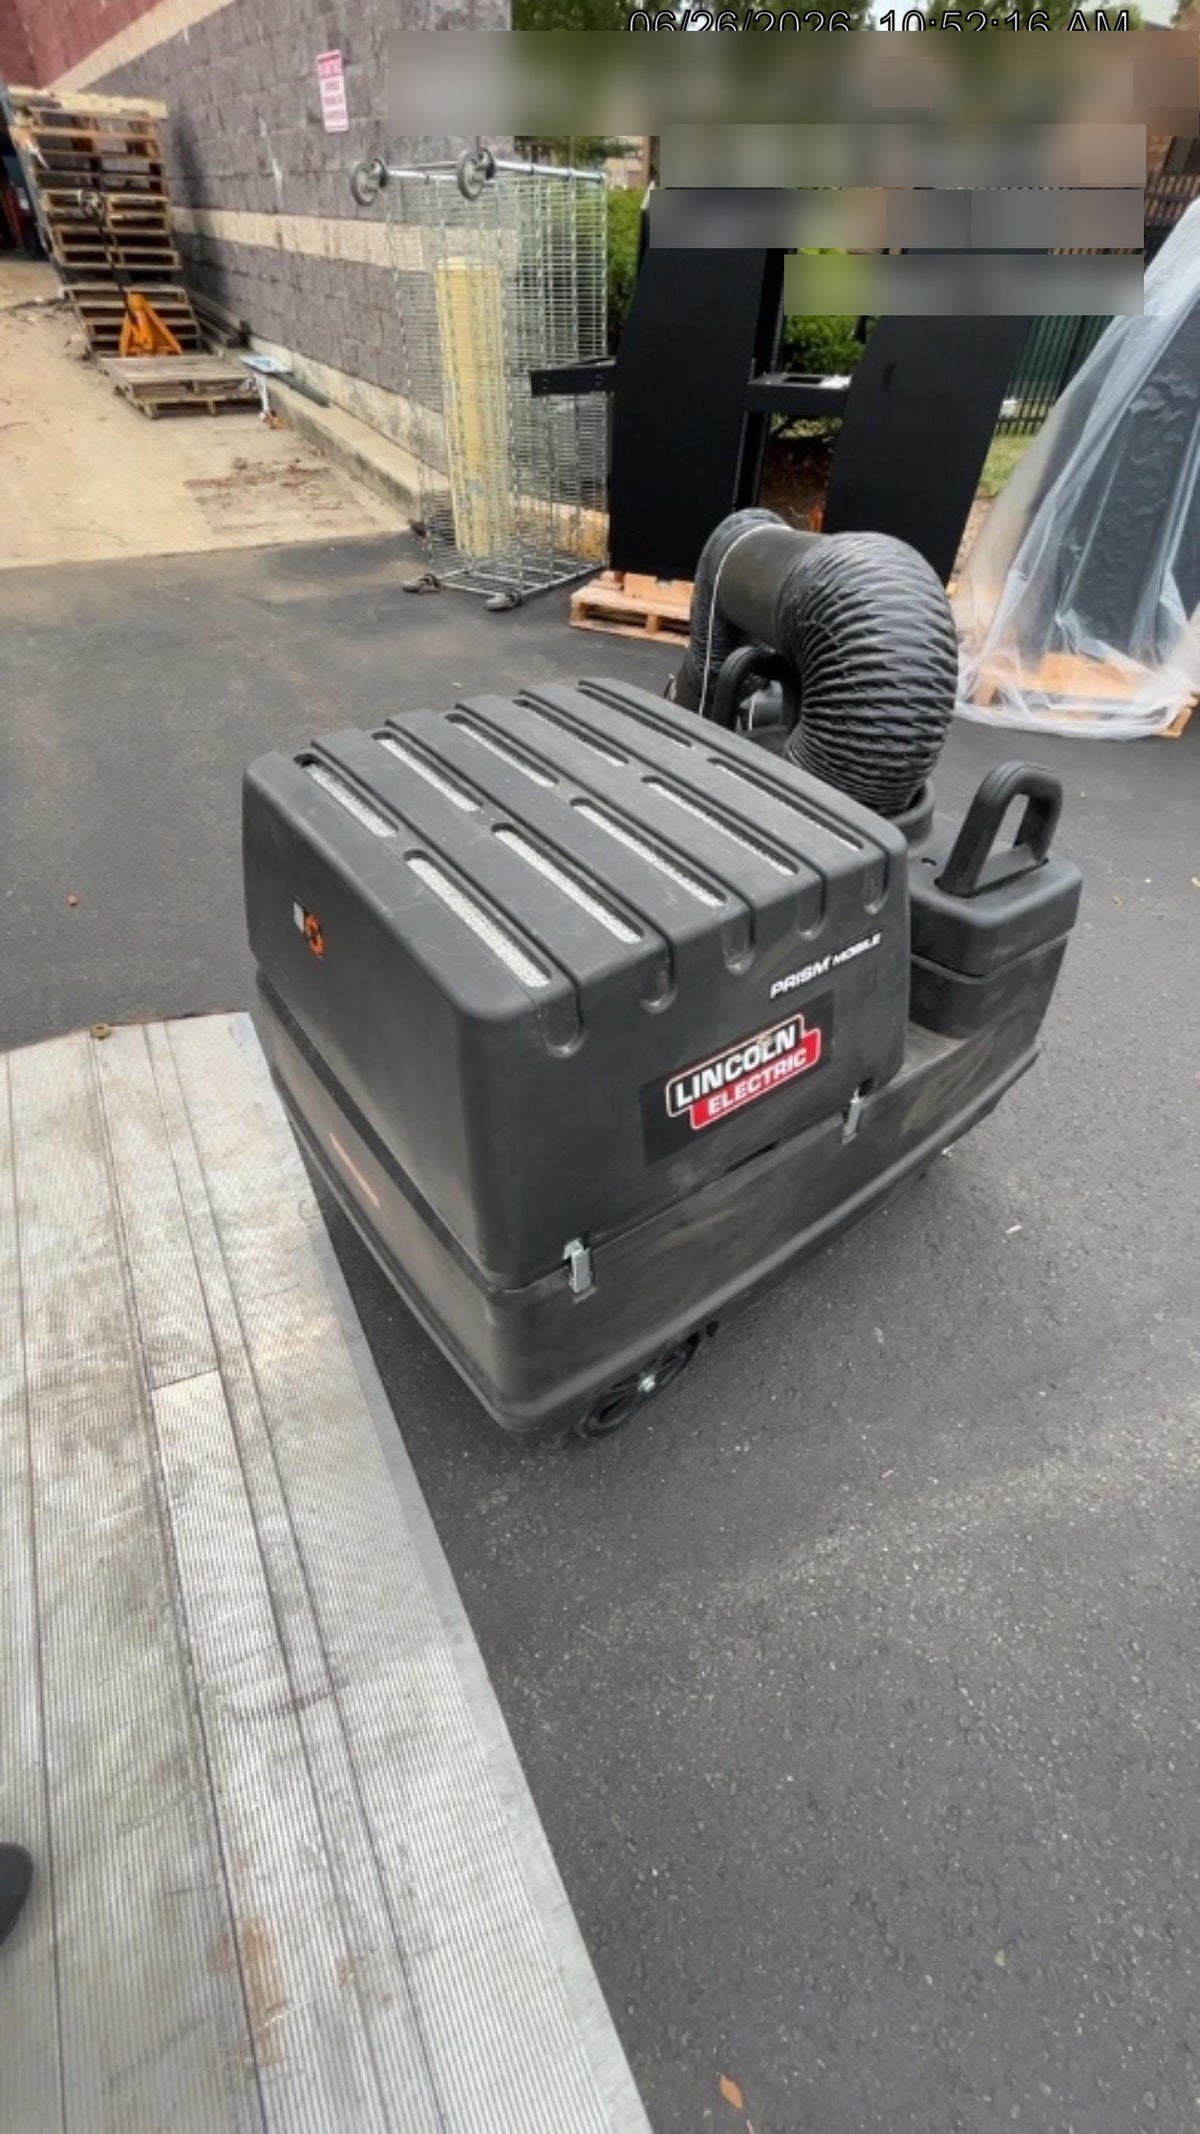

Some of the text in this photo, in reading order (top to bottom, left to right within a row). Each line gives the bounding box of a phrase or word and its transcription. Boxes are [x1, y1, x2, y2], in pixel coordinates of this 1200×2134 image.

[832, 932, 882, 966] MOBILE
[675, 1024, 796, 1109] LINCOLN
[708, 1049, 808, 1116] ELECTRIC
